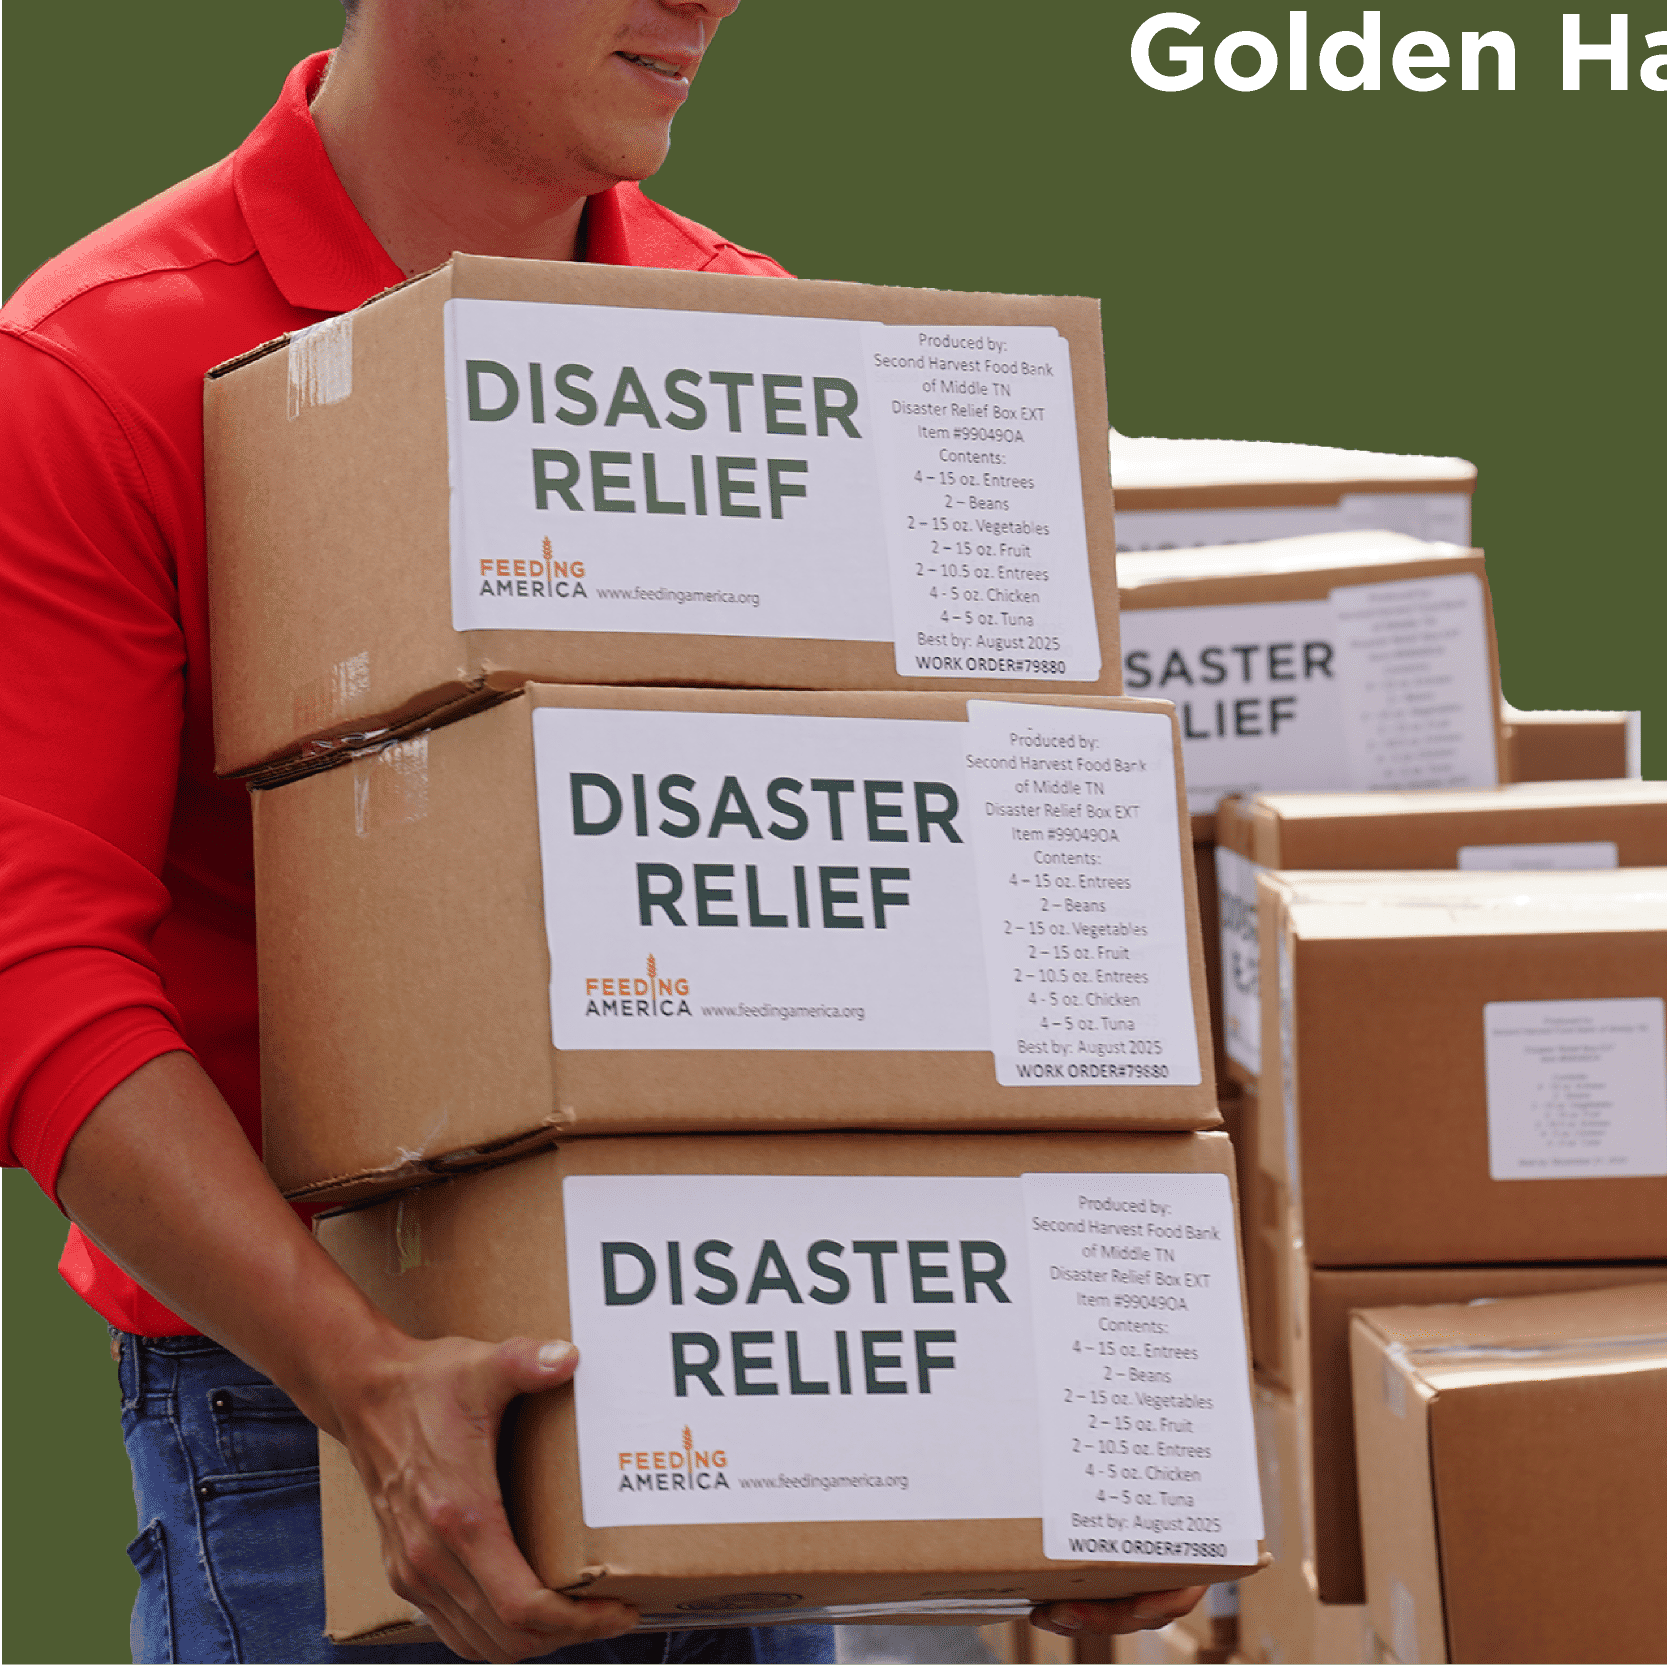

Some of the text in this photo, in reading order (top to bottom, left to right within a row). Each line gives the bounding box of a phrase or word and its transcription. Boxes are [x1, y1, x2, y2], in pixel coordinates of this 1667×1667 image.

[918, 332, 1008, 355] Produced by:
[872, 353, 1055, 376] Second Harvest Food Bank
[921, 378, 1012, 396] of Middle TN
[465, 358, 863, 439] DISASTER
[891, 400, 1046, 421] Disaster Relief Box EXT
[917, 426, 951, 439] Item
[938, 448, 1007, 464] Contents:
[531, 447, 809, 520] RELIEF
[913, 470, 924, 482] 4
[938, 471, 957, 485] 15
[958, 475, 981, 486] oz.
[982, 473, 1036, 489] Entrees
[944, 494, 953, 508] 2
[968, 495, 1010, 511] Beans
[906, 515, 916, 529] 2
[931, 517, 949, 531] 15
[952, 521, 973, 532] oz.
[974, 519, 1051, 536] Vegetables
[930, 540, 940, 554] 2
[955, 541, 974, 555] 15
[975, 545, 997, 556] oz.
[998, 543, 1032, 558] Fruit
[480, 557, 586, 579] FEEDING
[915, 562, 925, 576] 2
[939, 563, 971, 578] 10.5
[973, 568, 995, 579] oz.
[996, 565, 1050, 581] Entrees
[479, 580, 588, 598] AMERICA
[596, 586, 760, 607] www.feedingamerica.org
[929, 585, 939, 599] 4
[950, 586, 960, 601] 5
[962, 590, 984, 602] oz.
[986, 587, 1040, 604] Chicken
[939, 610, 951, 622] 4
[963, 611, 975, 625] 5
[976, 614, 999, 625] oz.
[999, 612, 1035, 627] Tuna
[916, 632, 1061, 652] Best by: August 2025
[914, 656, 1067, 674] WORK ORDER#79880
[1124, 641, 1336, 690] SASTER
[1181, 696, 1297, 741] LIEF
[1009, 733, 1100, 751] Produced by:
[965, 754, 1018, 770] Second
[1020, 756, 1074, 771] Harvest
[1076, 757, 1112, 772] Food
[1014, 779, 1105, 795] of Middle TN
[569, 771, 965, 844] DISASTER
[985, 802, 1141, 819] Disaster Relief Box EXT
[1011, 828, 1044, 841] Item
[1033, 850, 1102, 865] Contents:
[635, 862, 911, 929] RELIEF
[585, 977, 690, 996] FEEDING
[585, 999, 693, 1017] AMERICA
[700, 1002, 865, 1021] www.feedingamerica.org
[1017, 1040, 1163, 1057] Best by: August 2025
[1015, 1064, 1065, 1078] WORK
[1078, 1195, 1172, 1216] Produced by:
[1082, 1243, 1175, 1262] of Middle TN
[600, 1239, 1013, 1306] DISASTER
[1049, 1266, 1211, 1287] Disaster Relief Box EXT
[670, 1329, 958, 1397] RELIEF
[618, 1450, 729, 1470] FEEDING
[618, 1472, 731, 1492] AMERICA
[738, 1473, 910, 1492] www.feedingamerica.org
[1071, 1513, 1222, 1533] Best by: August 2025
[1068, 1538, 1118, 1553] WORK
